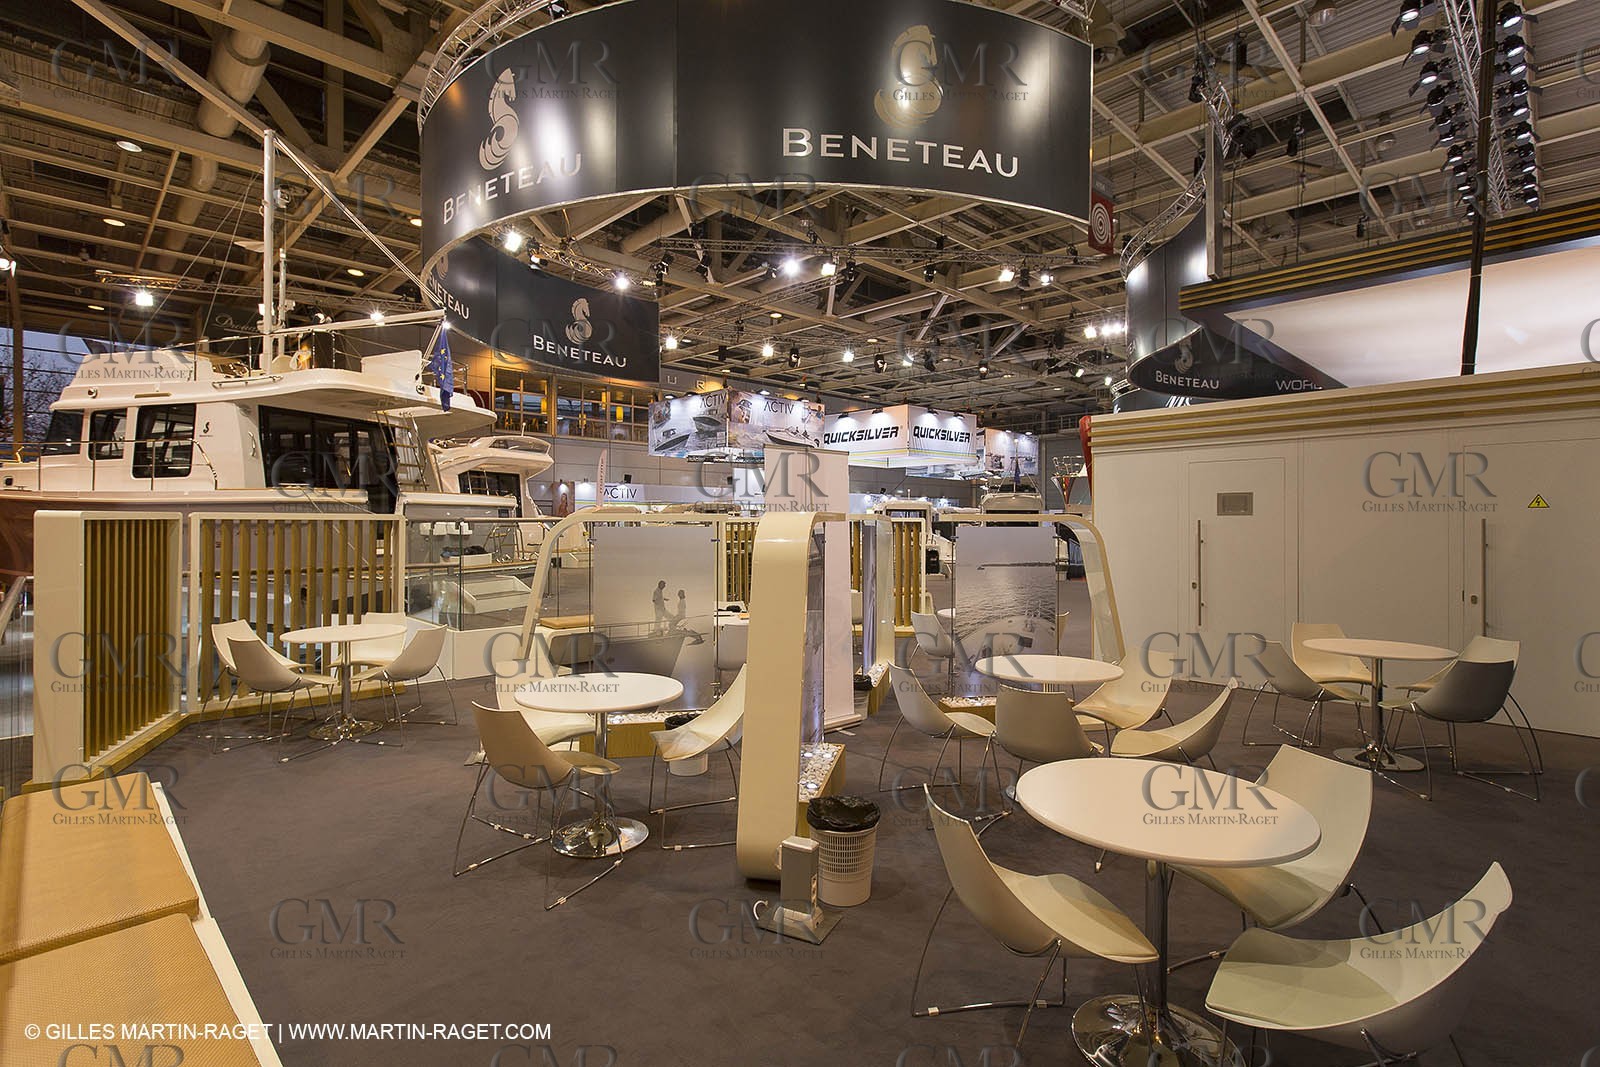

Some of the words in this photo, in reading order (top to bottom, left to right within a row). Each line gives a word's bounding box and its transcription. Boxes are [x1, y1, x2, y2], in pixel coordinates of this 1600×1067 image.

[783, 127, 1019, 178] BENETEAU
[442, 152, 582, 225] BENETEAU
[533, 335, 627, 368] BENETEAU
[1155, 370, 1220, 390] BENETEAU
[700, 388, 727, 409] ACTIV
[764, 401, 794, 415] ACTIV
[823, 425, 900, 445] QUICKSILVER
[913, 425, 971, 443] QUICKSILVER
[604, 487, 637, 499] ACTIV
